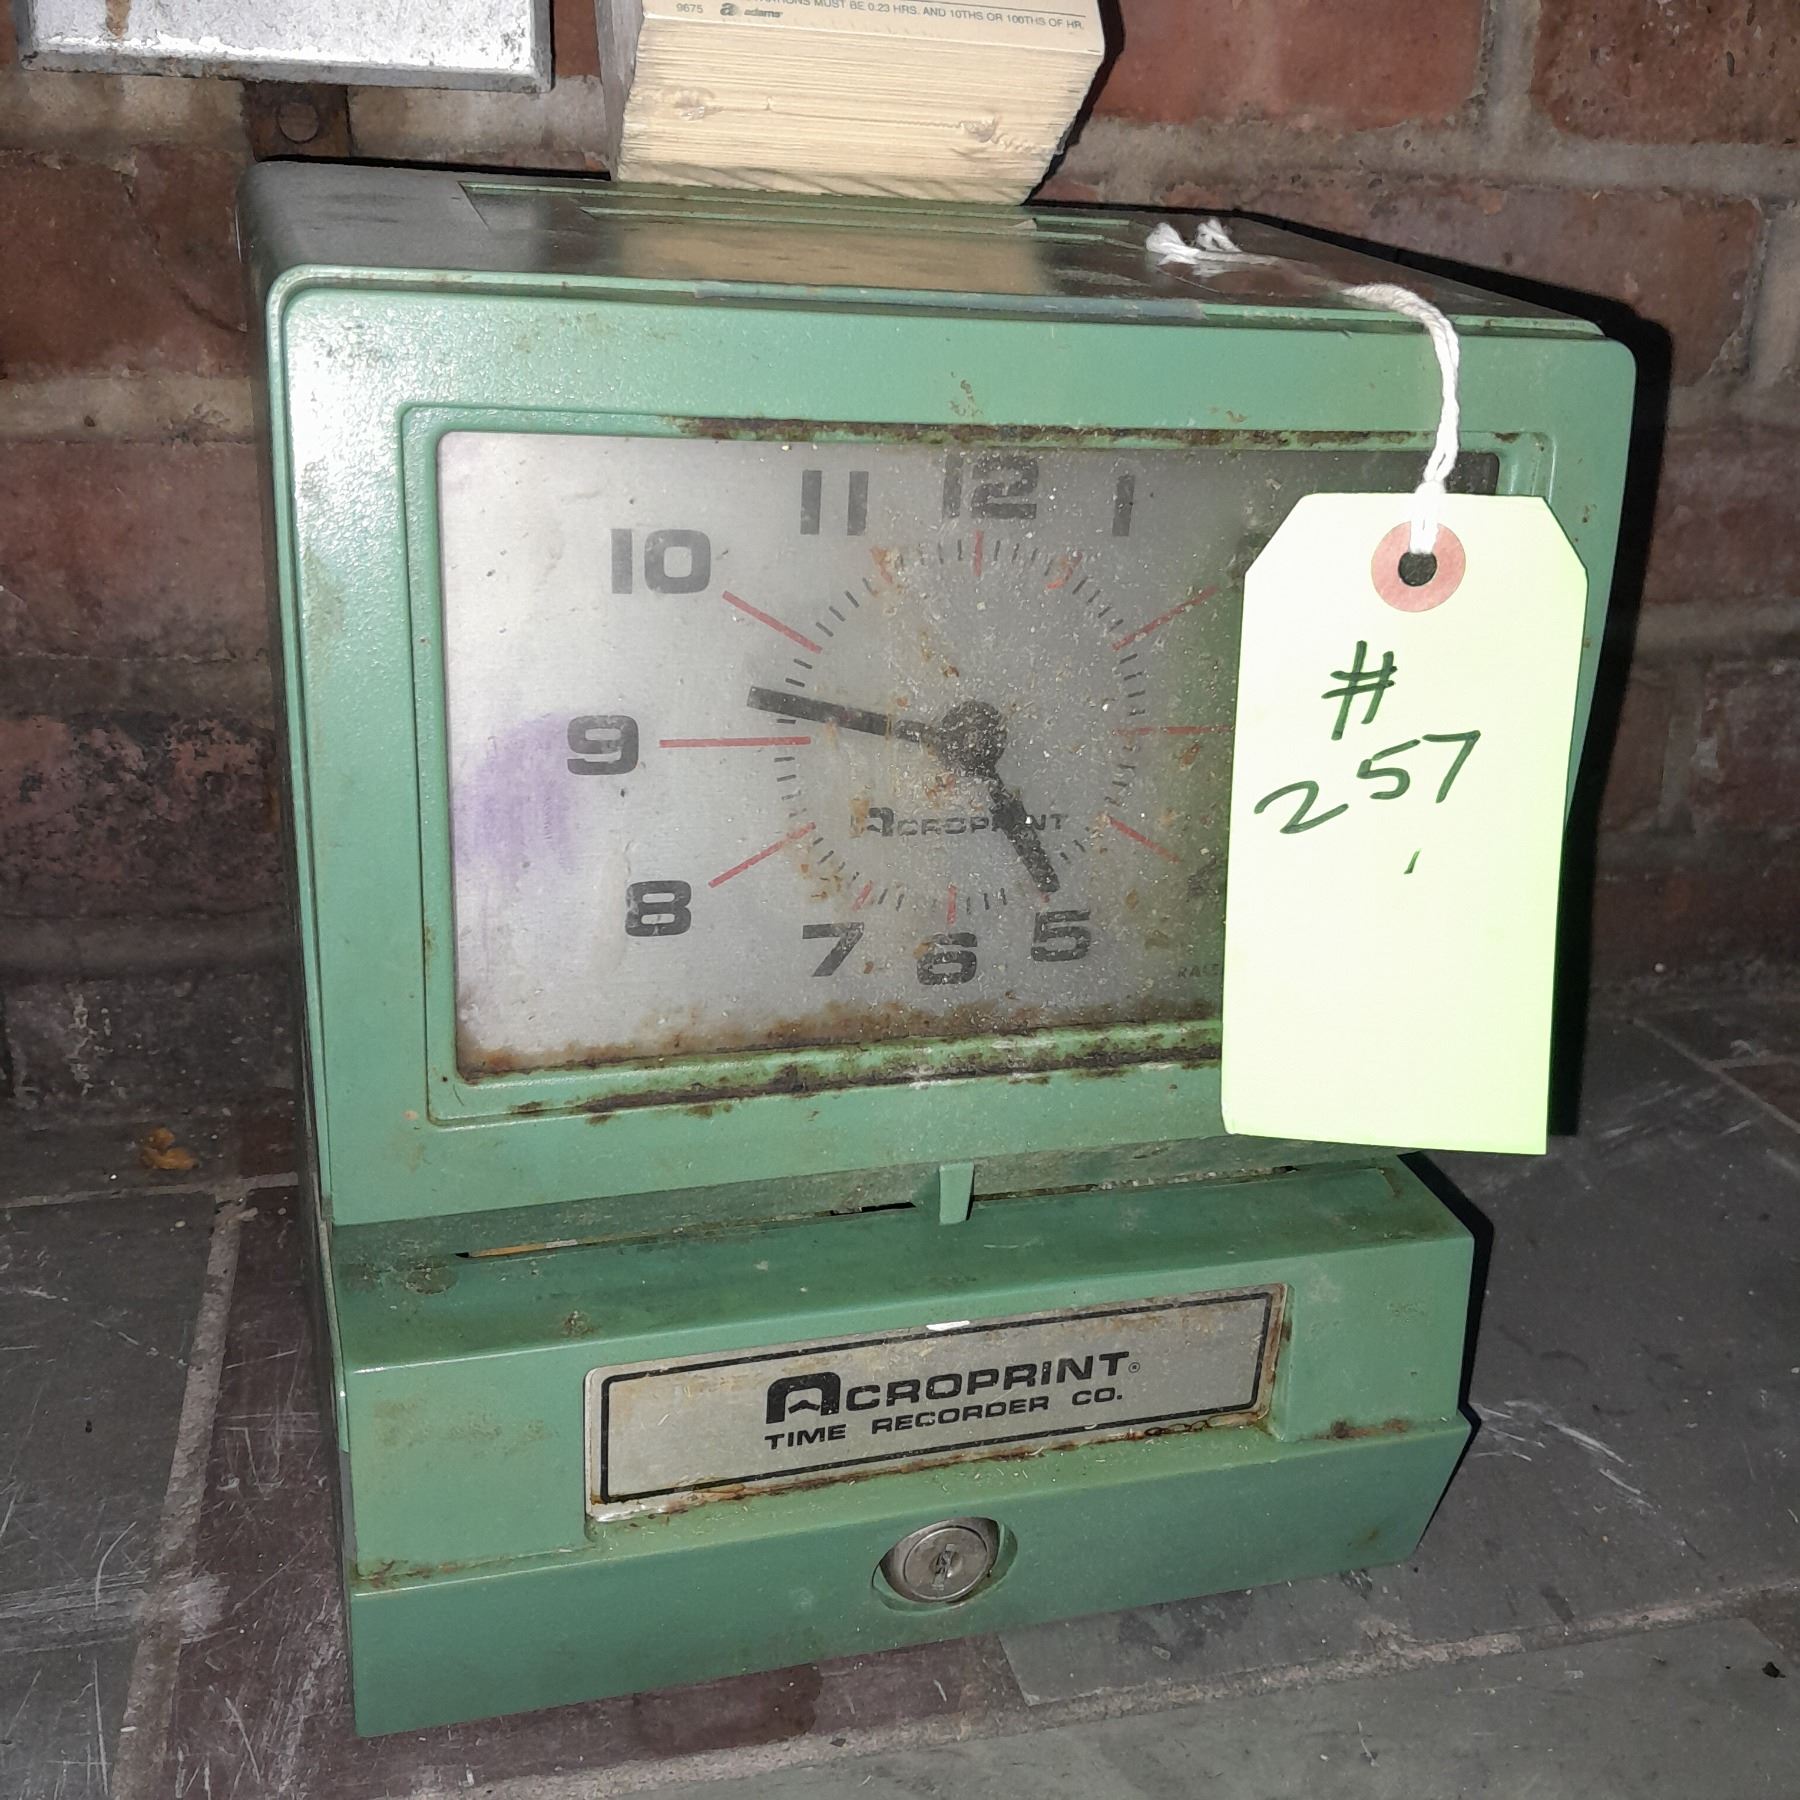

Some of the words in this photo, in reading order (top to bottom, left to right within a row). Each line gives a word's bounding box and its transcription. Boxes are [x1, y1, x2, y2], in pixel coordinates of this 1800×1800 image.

[676, 3, 704, 14] 9675
[849, 1, 867, 11] BE
[923, 7, 946, 17] AND
[986, 12, 1002, 22] OR
[1048, 18, 1063, 27] OF
[801, 469, 869, 536] 11
[942, 454, 1039, 521] 12
[1112, 474, 1136, 538] 1
[611, 527, 712, 595] 10
[566, 715, 640, 776] 9
[1253, 729, 1482, 835] 257
[851, 807, 1068, 837] ACROPNT
[625, 879, 693, 937] 8
[1030, 909, 1091, 962] 5
[802, 922, 865, 978] 7
[916, 932, 978, 986] 6
[765, 1423, 847, 1450] TIME
[871, 1395, 1049, 1435] RECORDER
[1071, 1386, 1123, 1407] CO.
